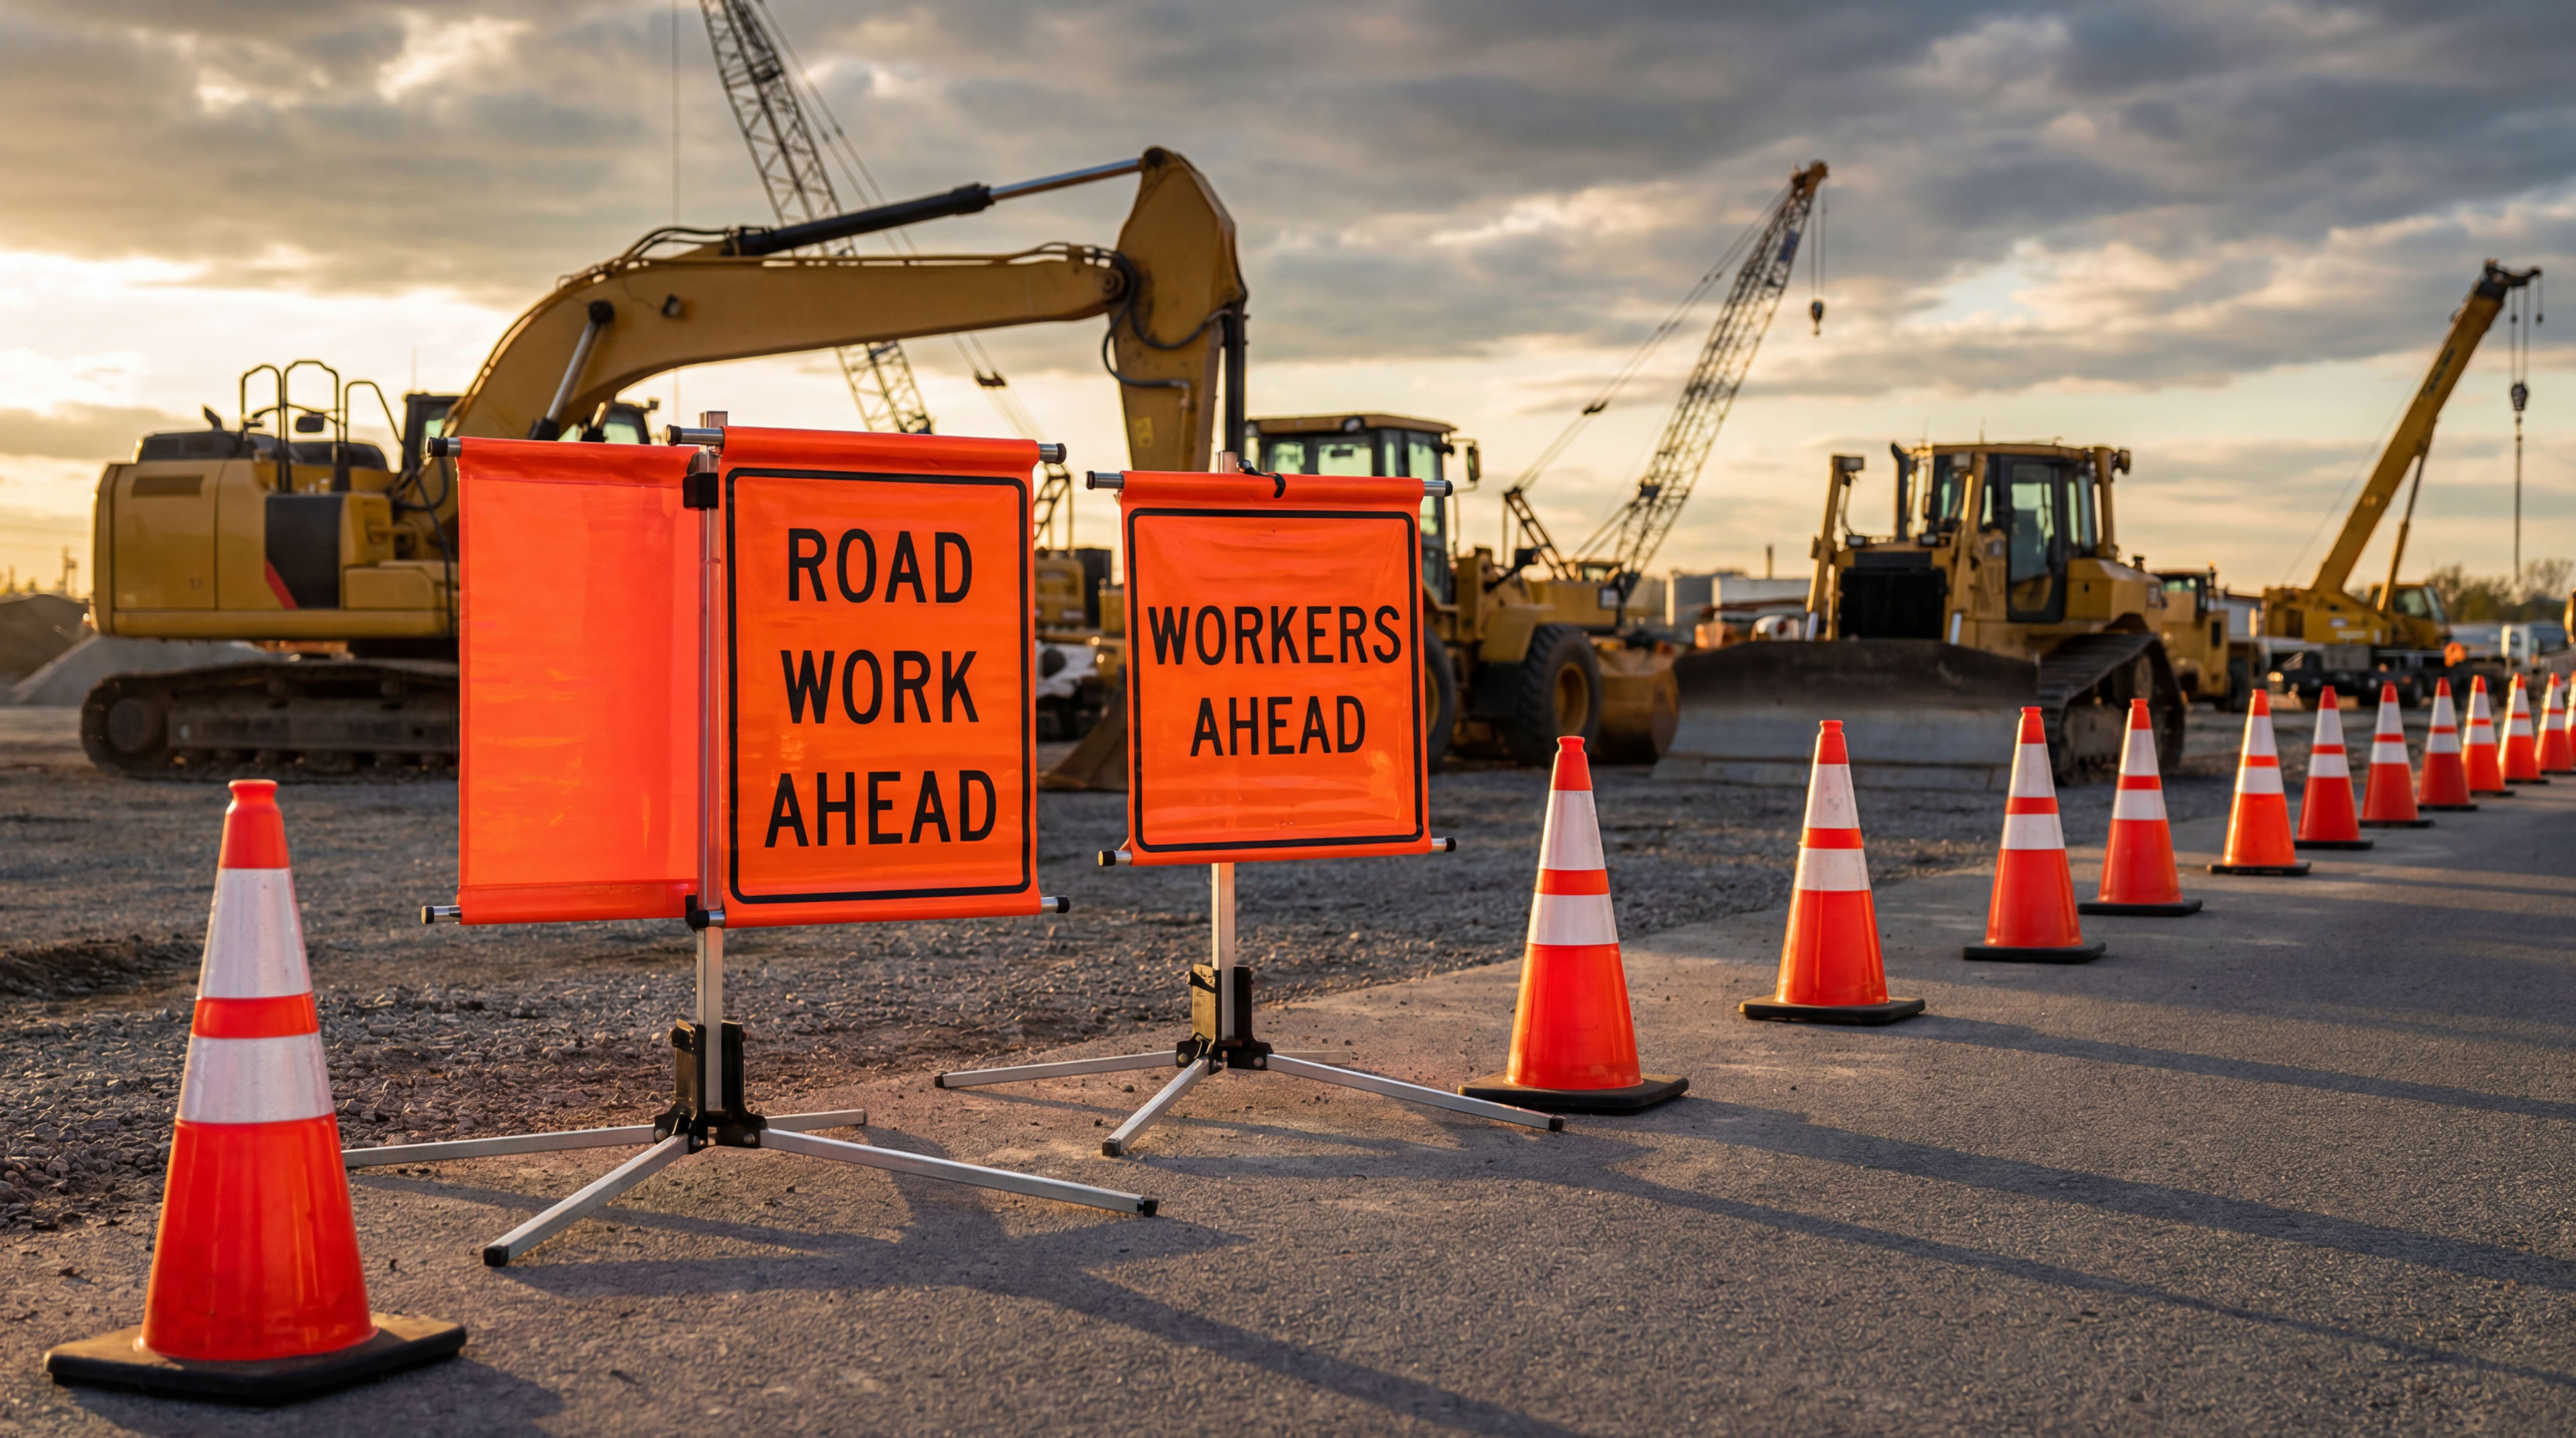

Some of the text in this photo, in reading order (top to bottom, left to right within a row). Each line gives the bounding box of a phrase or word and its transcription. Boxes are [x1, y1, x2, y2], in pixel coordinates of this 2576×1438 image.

[789, 529, 971, 603] ROAD
[1148, 605, 1401, 665] WORKERS
[781, 650, 978, 724] WORK
[1191, 696, 1365, 756] AHEAD
[765, 770, 996, 848] AHEAD
